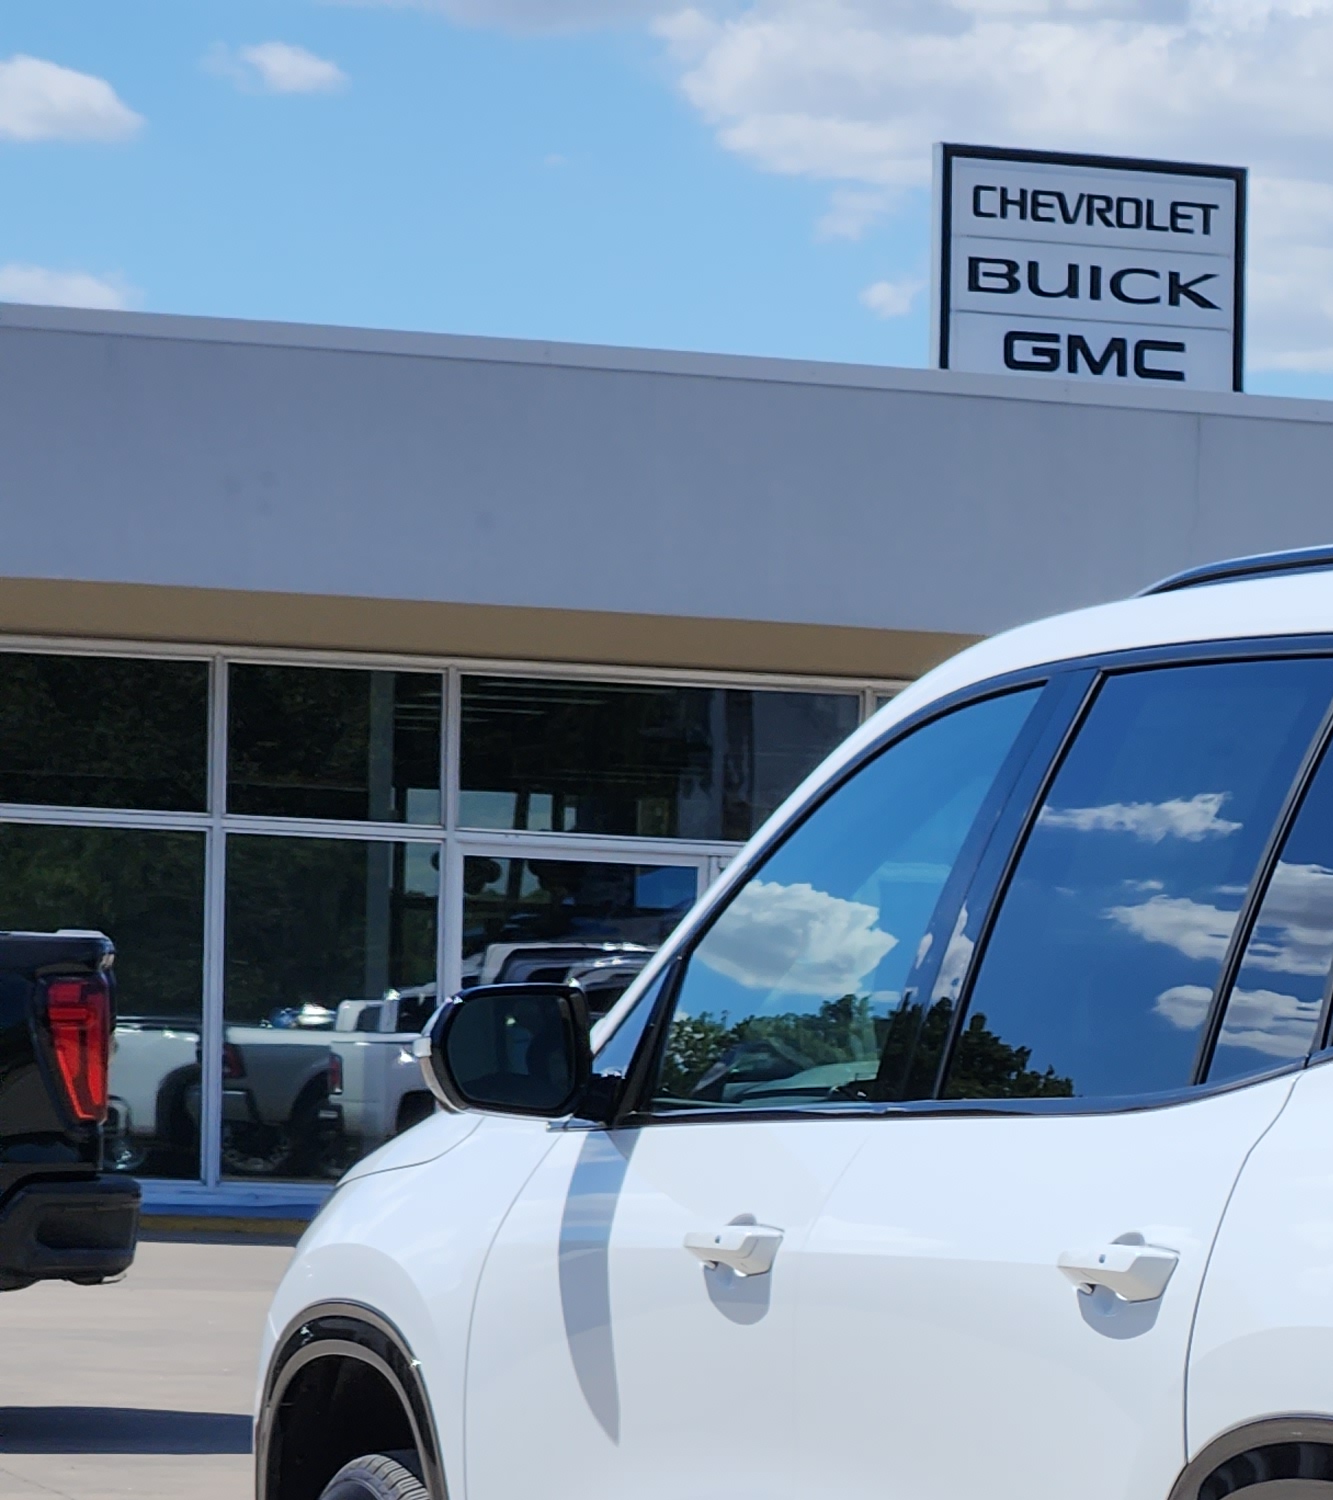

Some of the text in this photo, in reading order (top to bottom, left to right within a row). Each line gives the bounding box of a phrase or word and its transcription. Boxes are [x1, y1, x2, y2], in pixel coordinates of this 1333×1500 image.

[972, 185, 1220, 236] CHEVROLET
[968, 256, 1222, 311] BUICK
[1003, 330, 1186, 382] GMC
